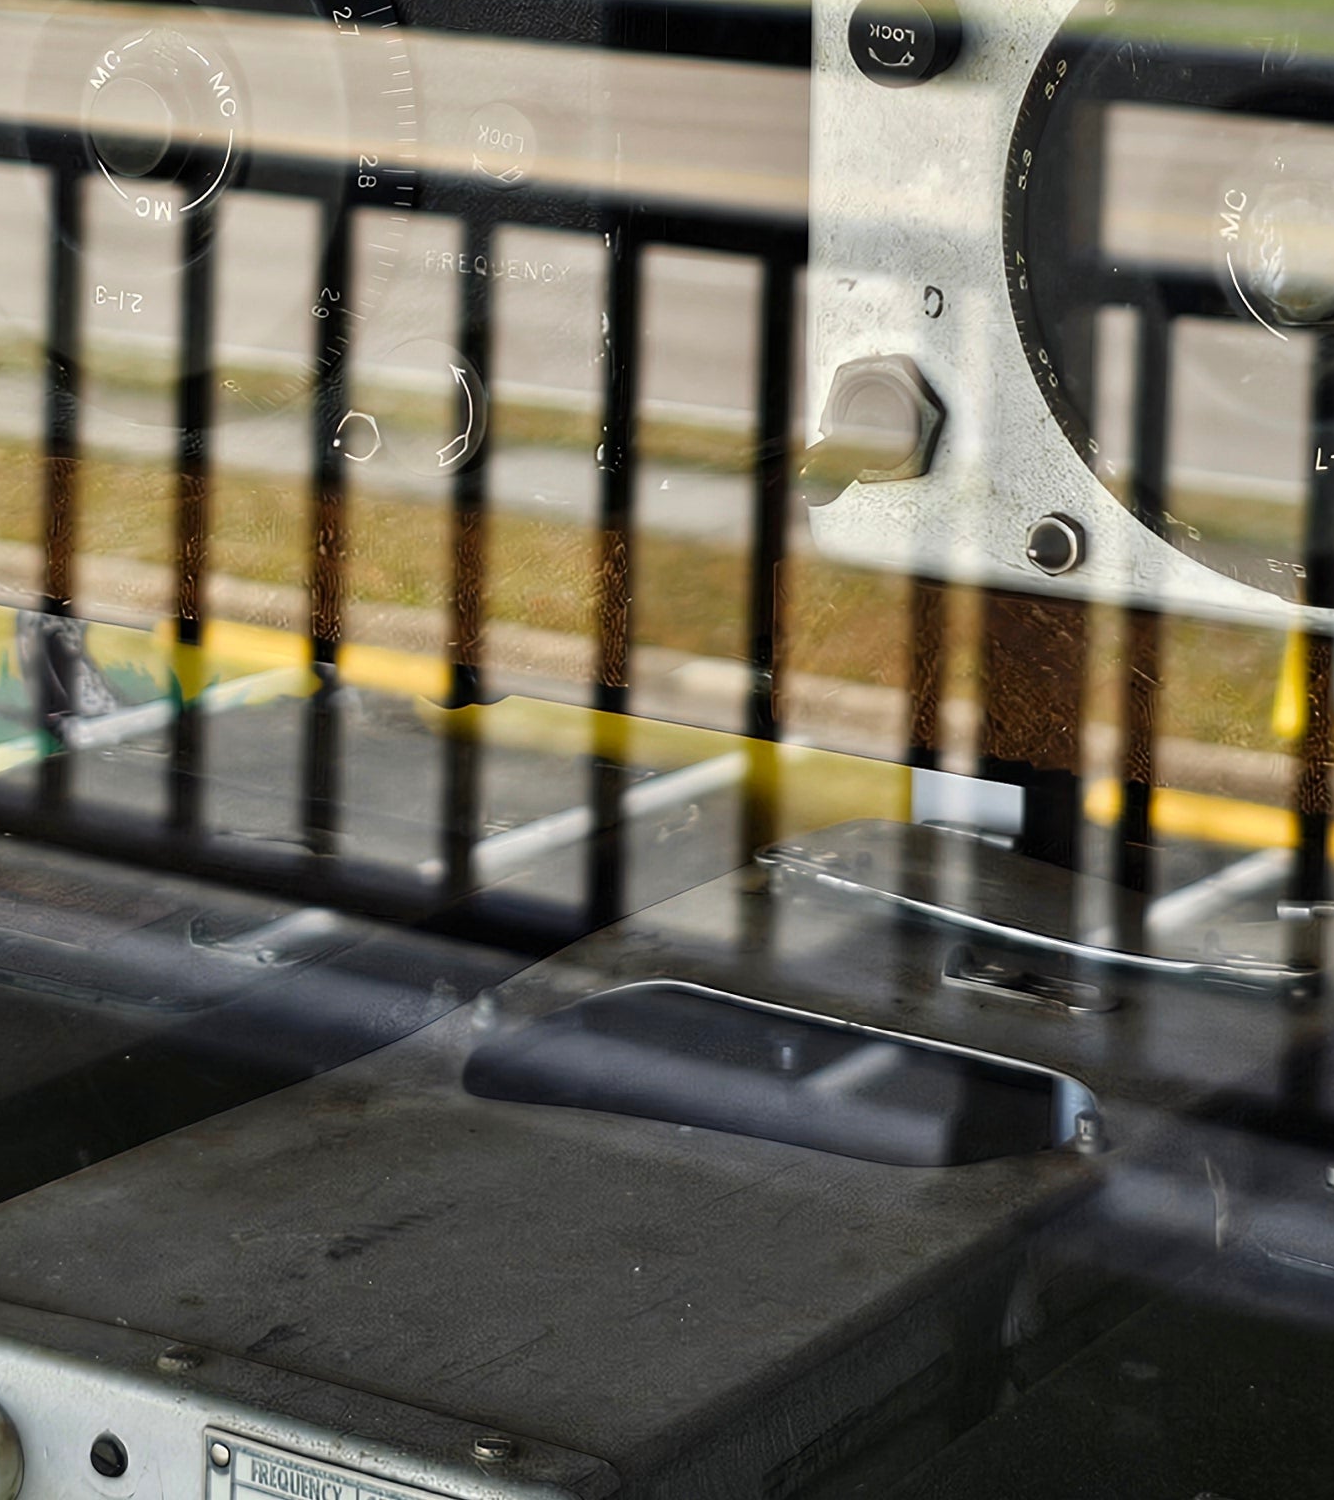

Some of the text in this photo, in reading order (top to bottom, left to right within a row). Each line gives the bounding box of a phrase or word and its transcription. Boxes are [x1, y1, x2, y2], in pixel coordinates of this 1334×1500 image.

[333, 6, 360, 37] 2.7
[869, 23, 915, 44] LOCK
[90, 50, 120, 89] MC
[209, 71, 236, 117] MC
[477, 124, 524, 154] LOCK
[358, 154, 378, 189] 2.8
[135, 196, 172, 221] MC
[1220, 189, 1247, 240] MC
[424, 250, 570, 283] FREQUENCY
[311, 287, 340, 319] 2.9
[250, 1458, 342, 1500] FREQUENCY
